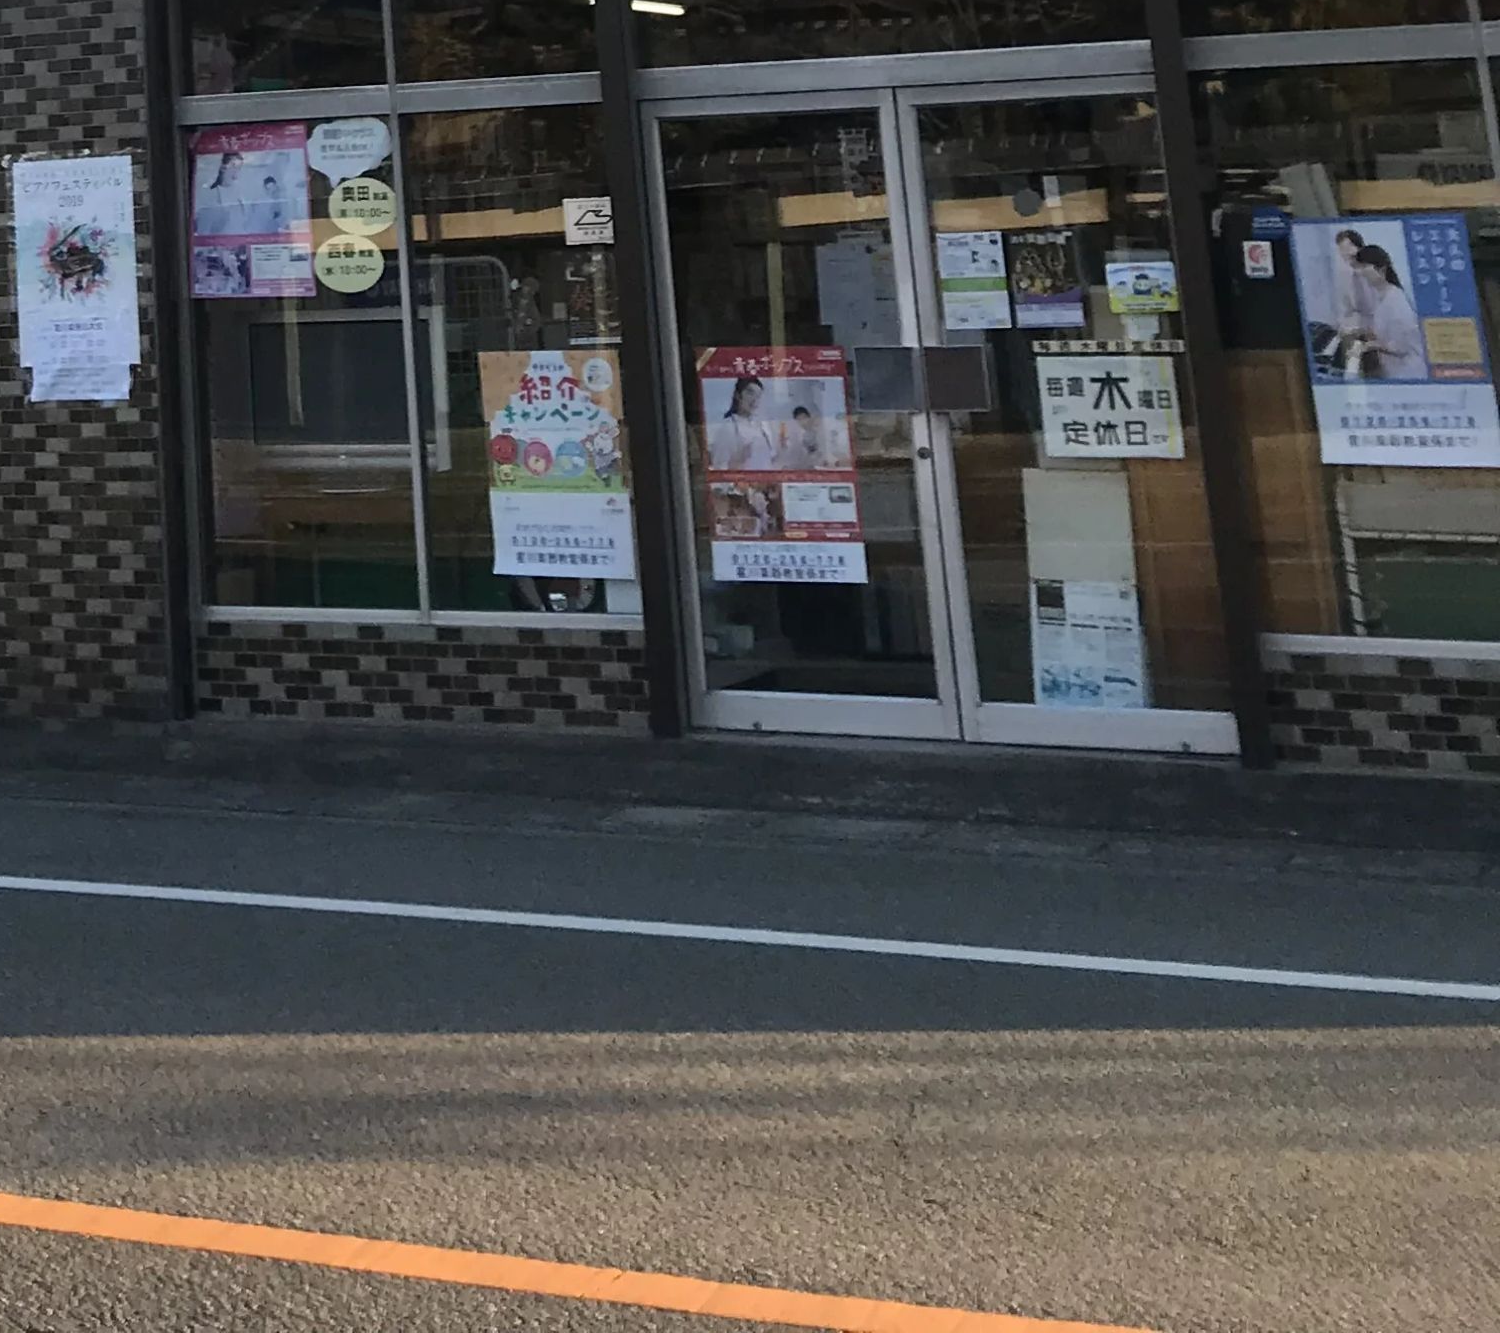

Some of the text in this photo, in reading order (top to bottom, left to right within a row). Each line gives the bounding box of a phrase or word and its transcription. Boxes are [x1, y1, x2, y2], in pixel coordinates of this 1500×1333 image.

[518, 372, 581, 405] 紹介
[503, 403, 601, 424] キャンペーン
